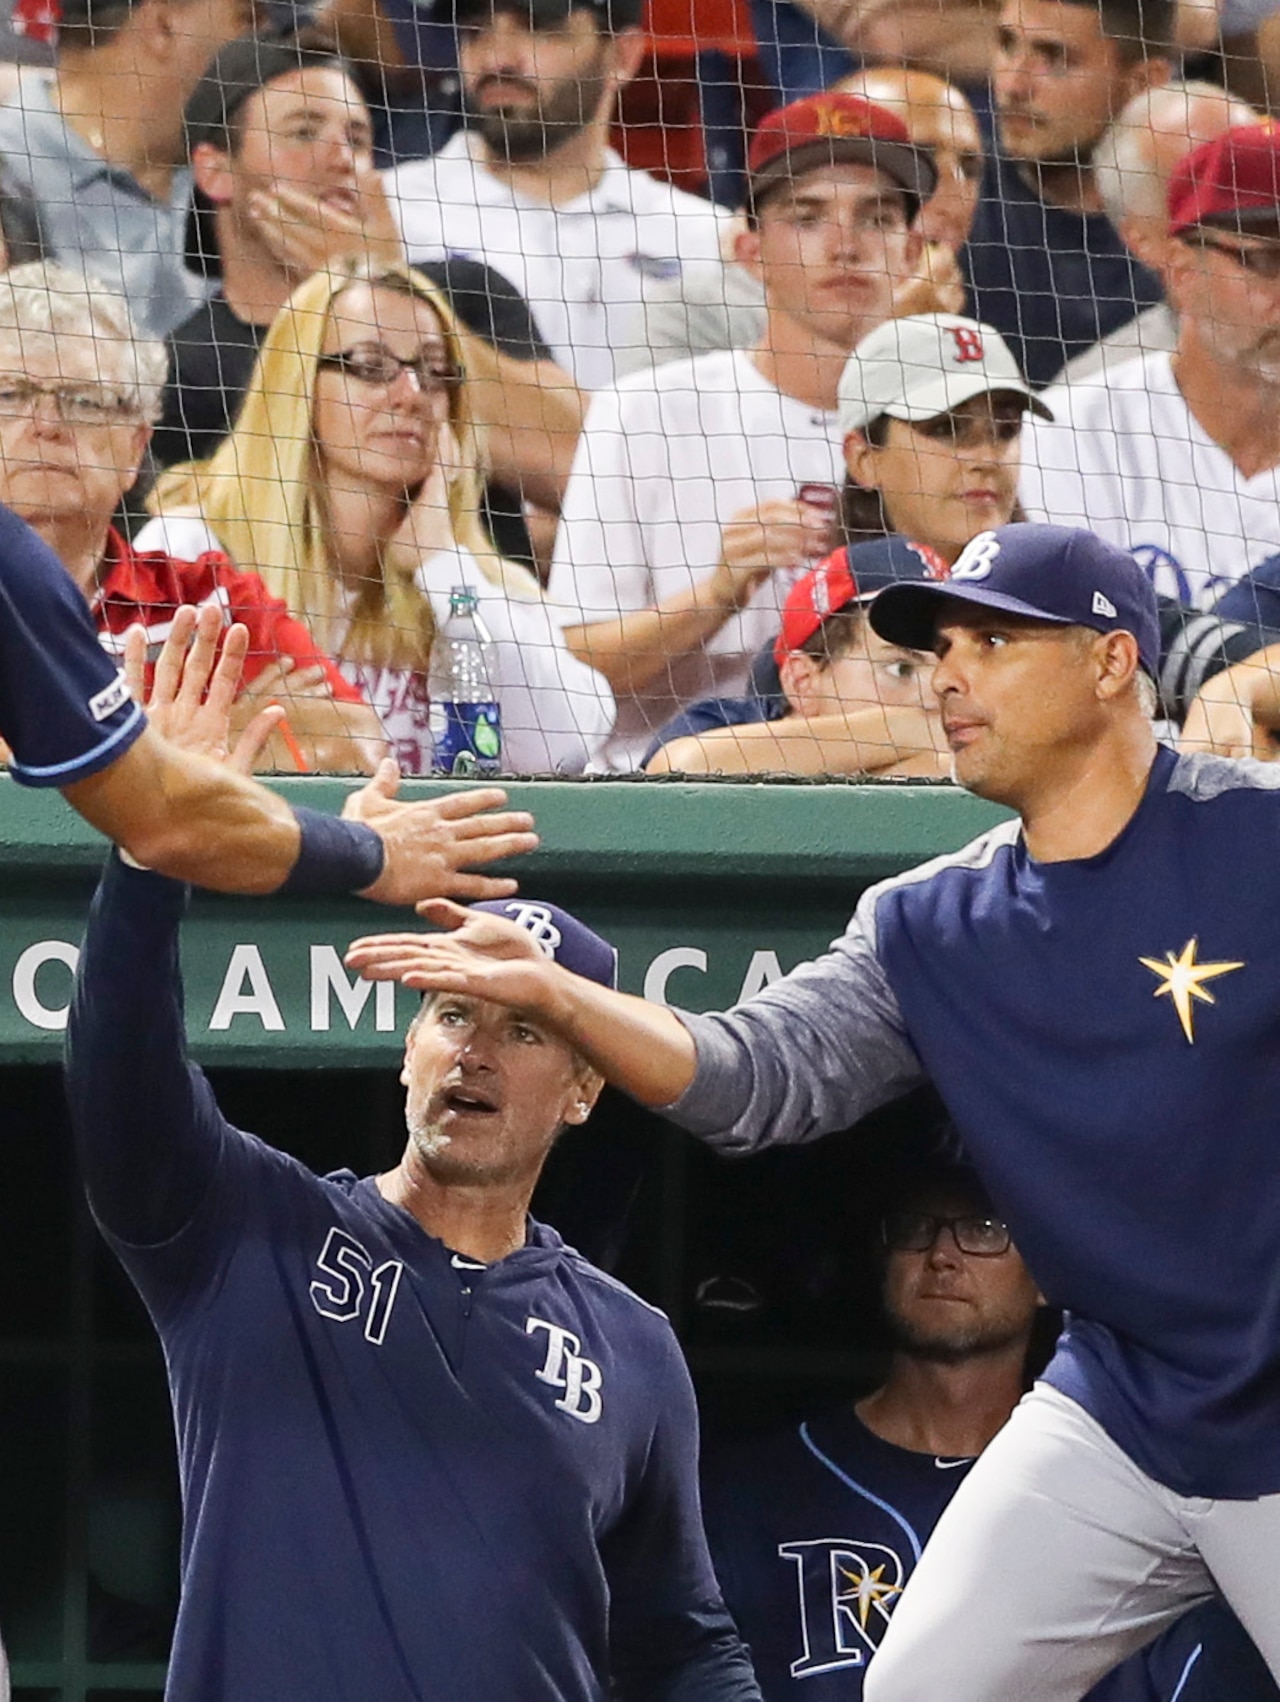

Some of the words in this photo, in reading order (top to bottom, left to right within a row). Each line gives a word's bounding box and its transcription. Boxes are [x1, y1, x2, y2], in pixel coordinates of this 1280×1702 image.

[942, 326, 984, 363] B
[310, 1227, 404, 1345] 51
[525, 1316, 603, 1423] TB
